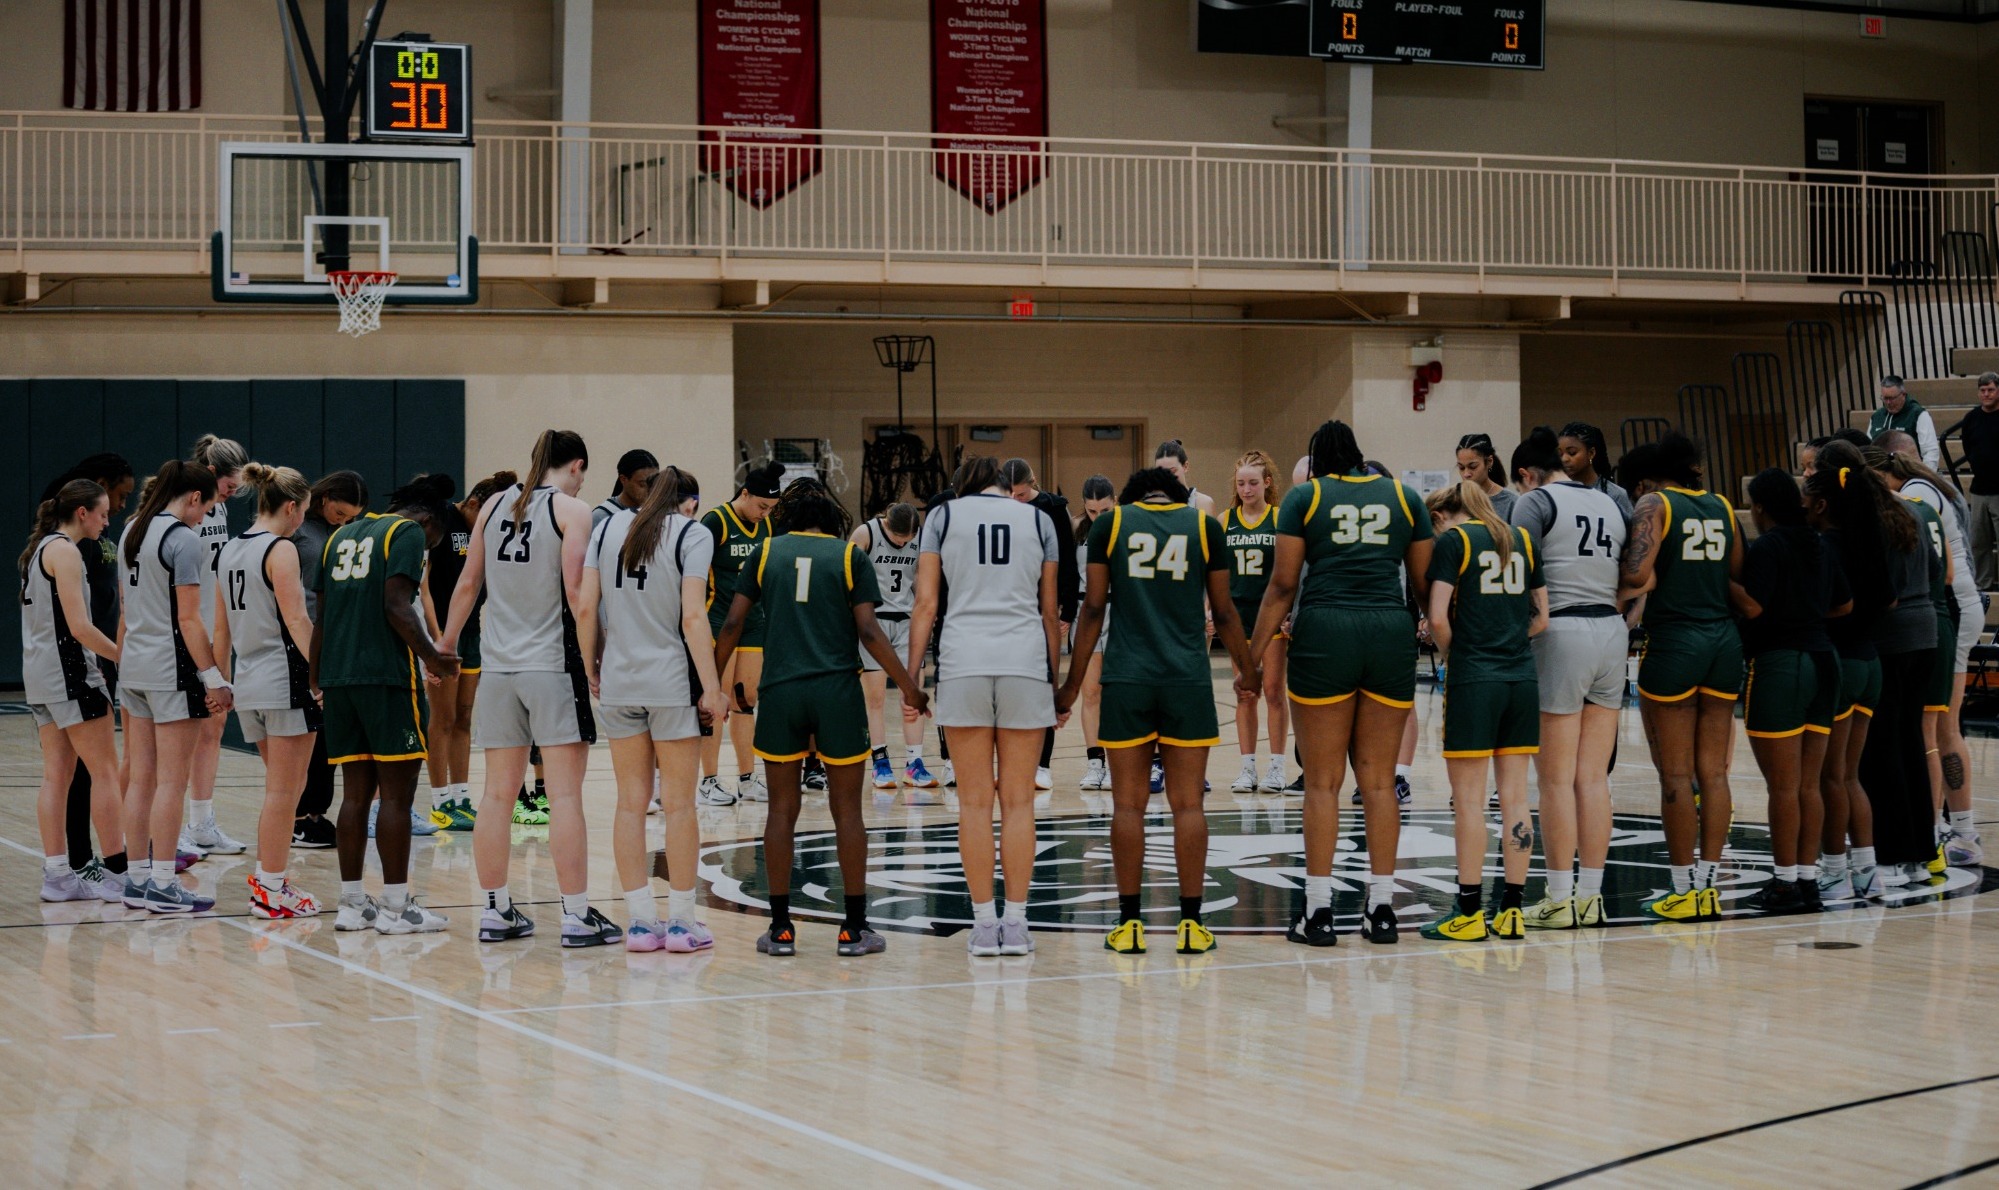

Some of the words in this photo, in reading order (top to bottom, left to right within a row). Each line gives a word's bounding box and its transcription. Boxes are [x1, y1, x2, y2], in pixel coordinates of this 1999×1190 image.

[734, 0, 781, 9] National
[1331, 0, 1363, 9] FOULS
[1395, 2, 1463, 16] PLAYER-FOUL
[716, 9, 800, 23] Championships
[966, 6, 1009, 18] National
[1494, 9, 1525, 19] FOULS
[718, 25, 760, 34] WOMEN'S
[761, 27, 800, 35] CYCLING
[947, 17, 1027, 32] Championships
[949, 33, 989, 42] WOMEN'S
[991, 35, 1027, 44] CYCLING
[992, 44, 1015, 52] Track
[1328, 43, 1364, 54] POINTS
[1395, 45, 1431, 57] MATCH
[949, 51, 983, 59] National
[985, 52, 1029, 61] Champions
[1491, 52, 1526, 64] POINTS
[956, 86, 992, 94] Women's
[994, 87, 1024, 98] Cycling
[389, 81, 447, 129] 30
[994, 96, 1015, 104] Road
[950, 104, 984, 112] National
[986, 105, 1030, 114] Champions
[723, 111, 761, 120] Women's
[763, 113, 795, 123] Cycling
[1330, 503, 1391, 545] 32
[497, 519, 533, 563] 23
[1575, 515, 1613, 558] 24
[1682, 518, 1726, 561] 25
[977, 523, 1011, 566] 10
[331, 536, 373, 581] 33
[874, 555, 917, 566] ASBURY
[1127, 533, 1188, 581] 24
[1233, 549, 1264, 575] 12
[615, 551, 648, 591] 14
[1478, 550, 1525, 595] 20
[795, 556, 813, 602] 1
[890, 569, 903, 593] 3
[229, 569, 248, 611] 12
